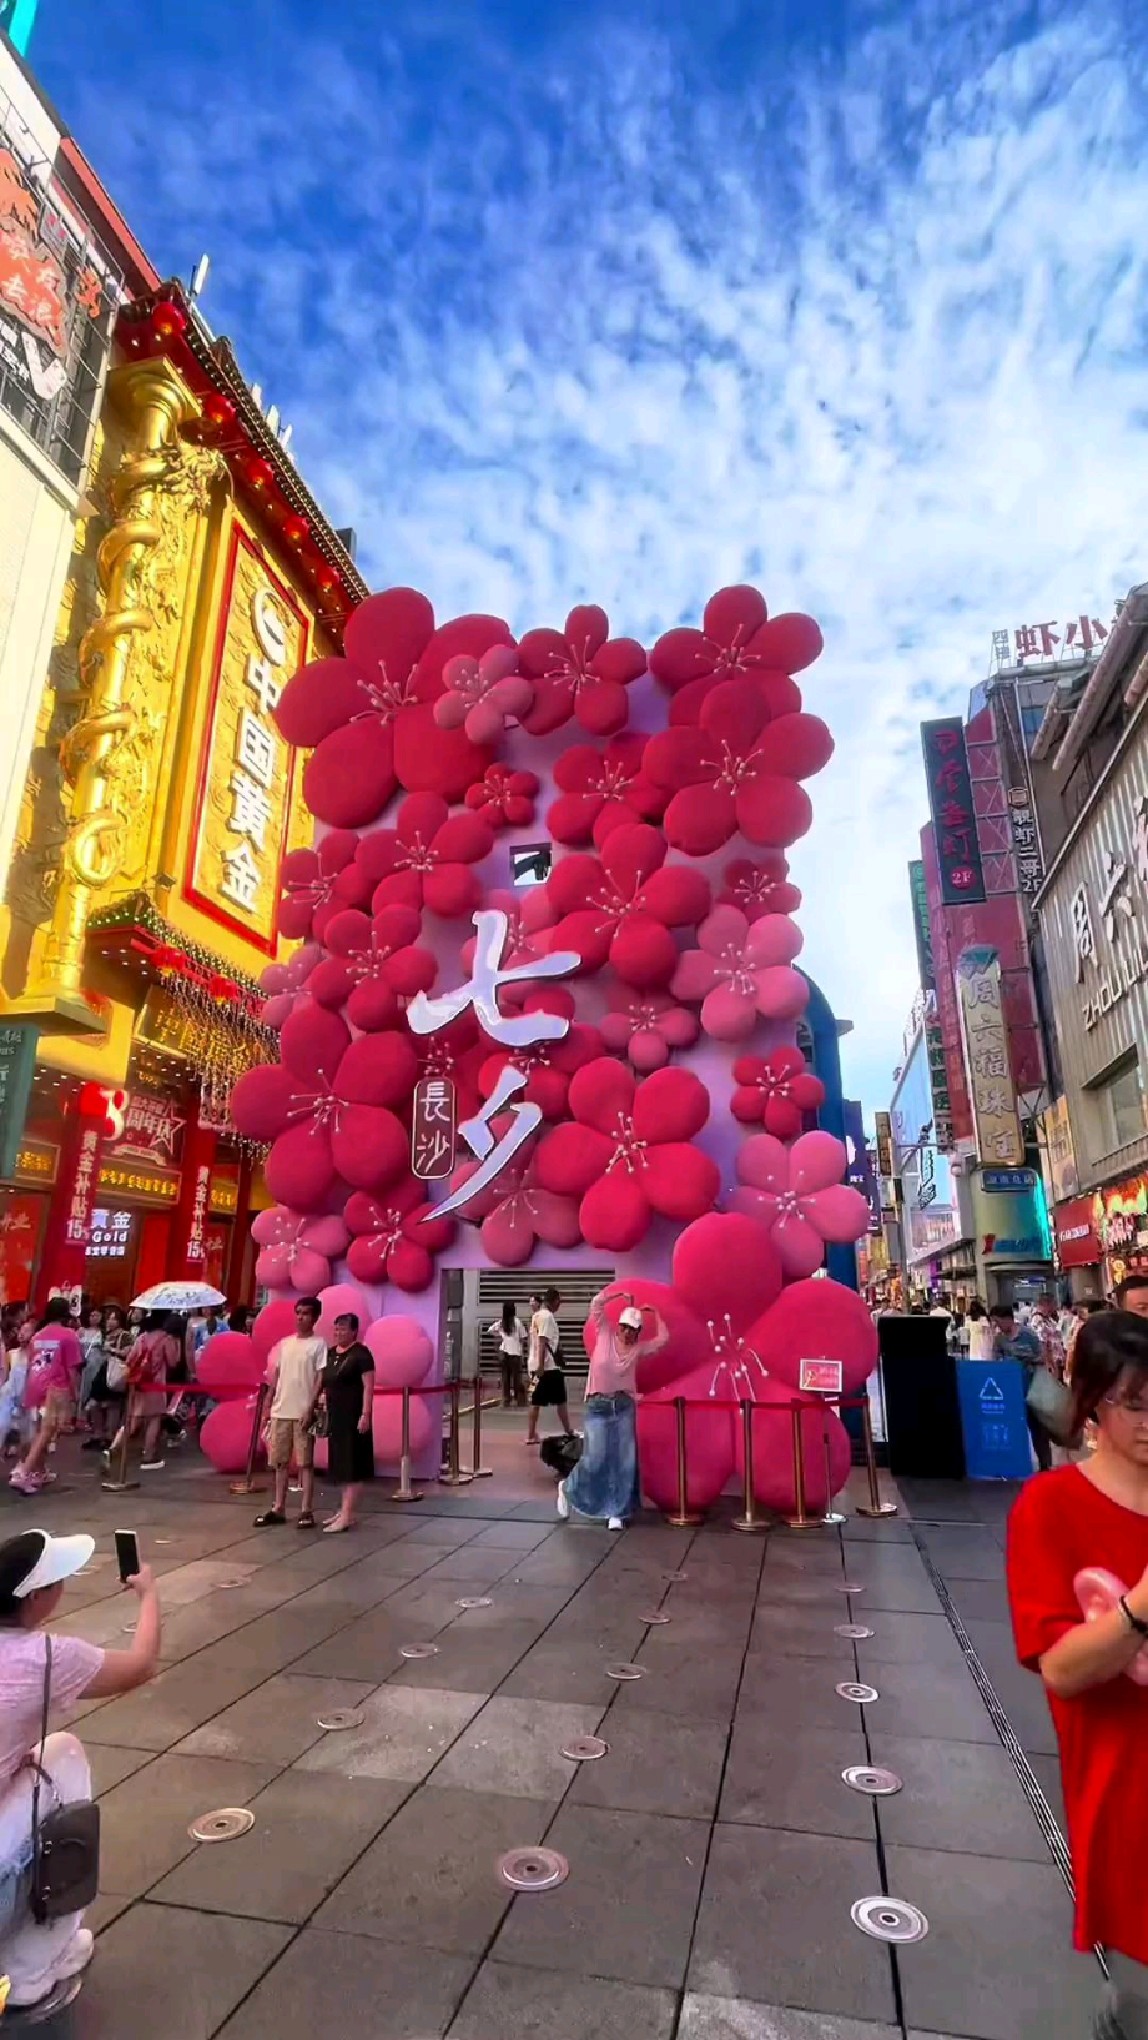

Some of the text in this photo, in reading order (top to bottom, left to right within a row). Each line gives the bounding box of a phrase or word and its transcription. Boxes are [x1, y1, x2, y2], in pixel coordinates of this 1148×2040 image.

[221, 653, 280, 912] 中国黄金
[952, 870, 973, 885] 2F
[406, 909, 582, 1222] 七夕
[966, 976, 1017, 1161] 周六福珠宝
[92, 1230, 128, 1243] Gold
